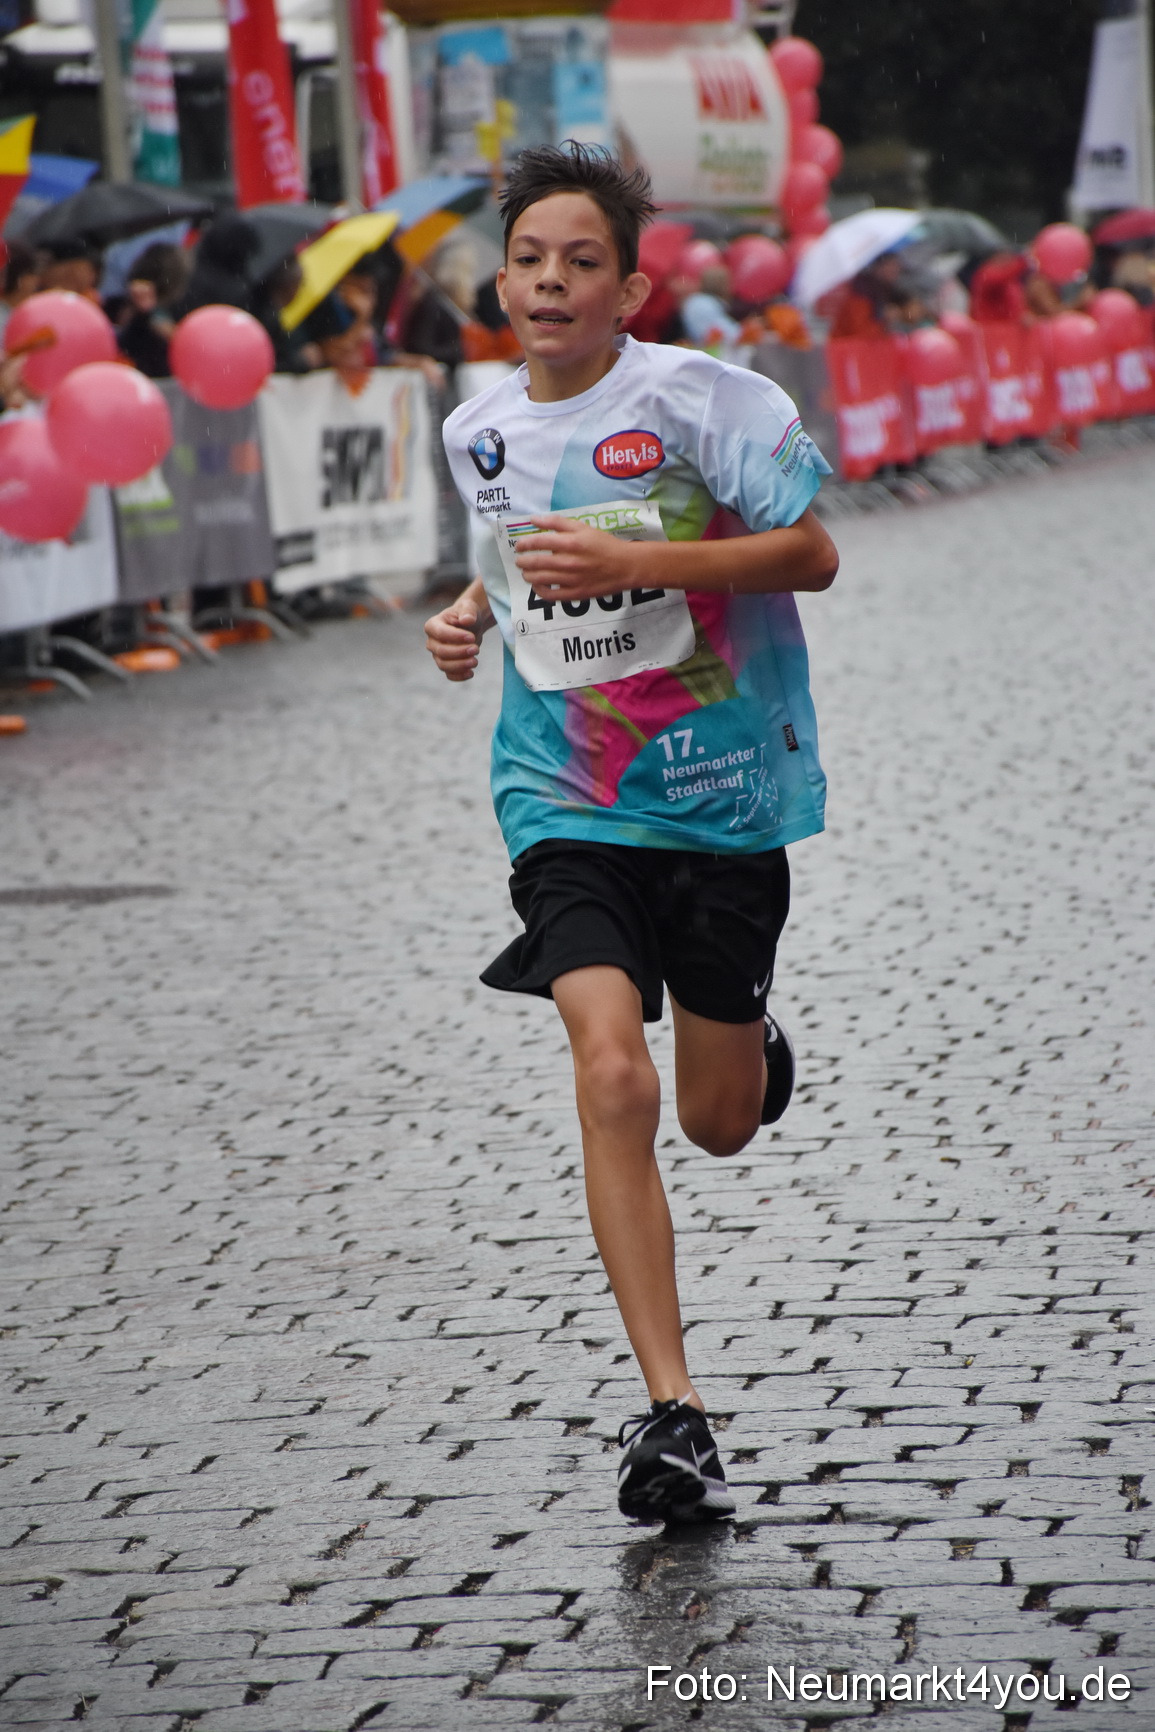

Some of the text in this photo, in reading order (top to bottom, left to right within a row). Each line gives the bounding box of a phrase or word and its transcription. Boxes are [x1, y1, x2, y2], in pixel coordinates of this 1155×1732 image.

[601, 442, 659, 466] Hervis
[476, 486, 511, 504] PARTL
[476, 500, 512, 514] Neumarkt
[562, 630, 637, 663] Morris
[656, 728, 705, 762] 17.
[662, 747, 756, 782] Neumarkter
[666, 769, 744, 802] Stadtlauf
